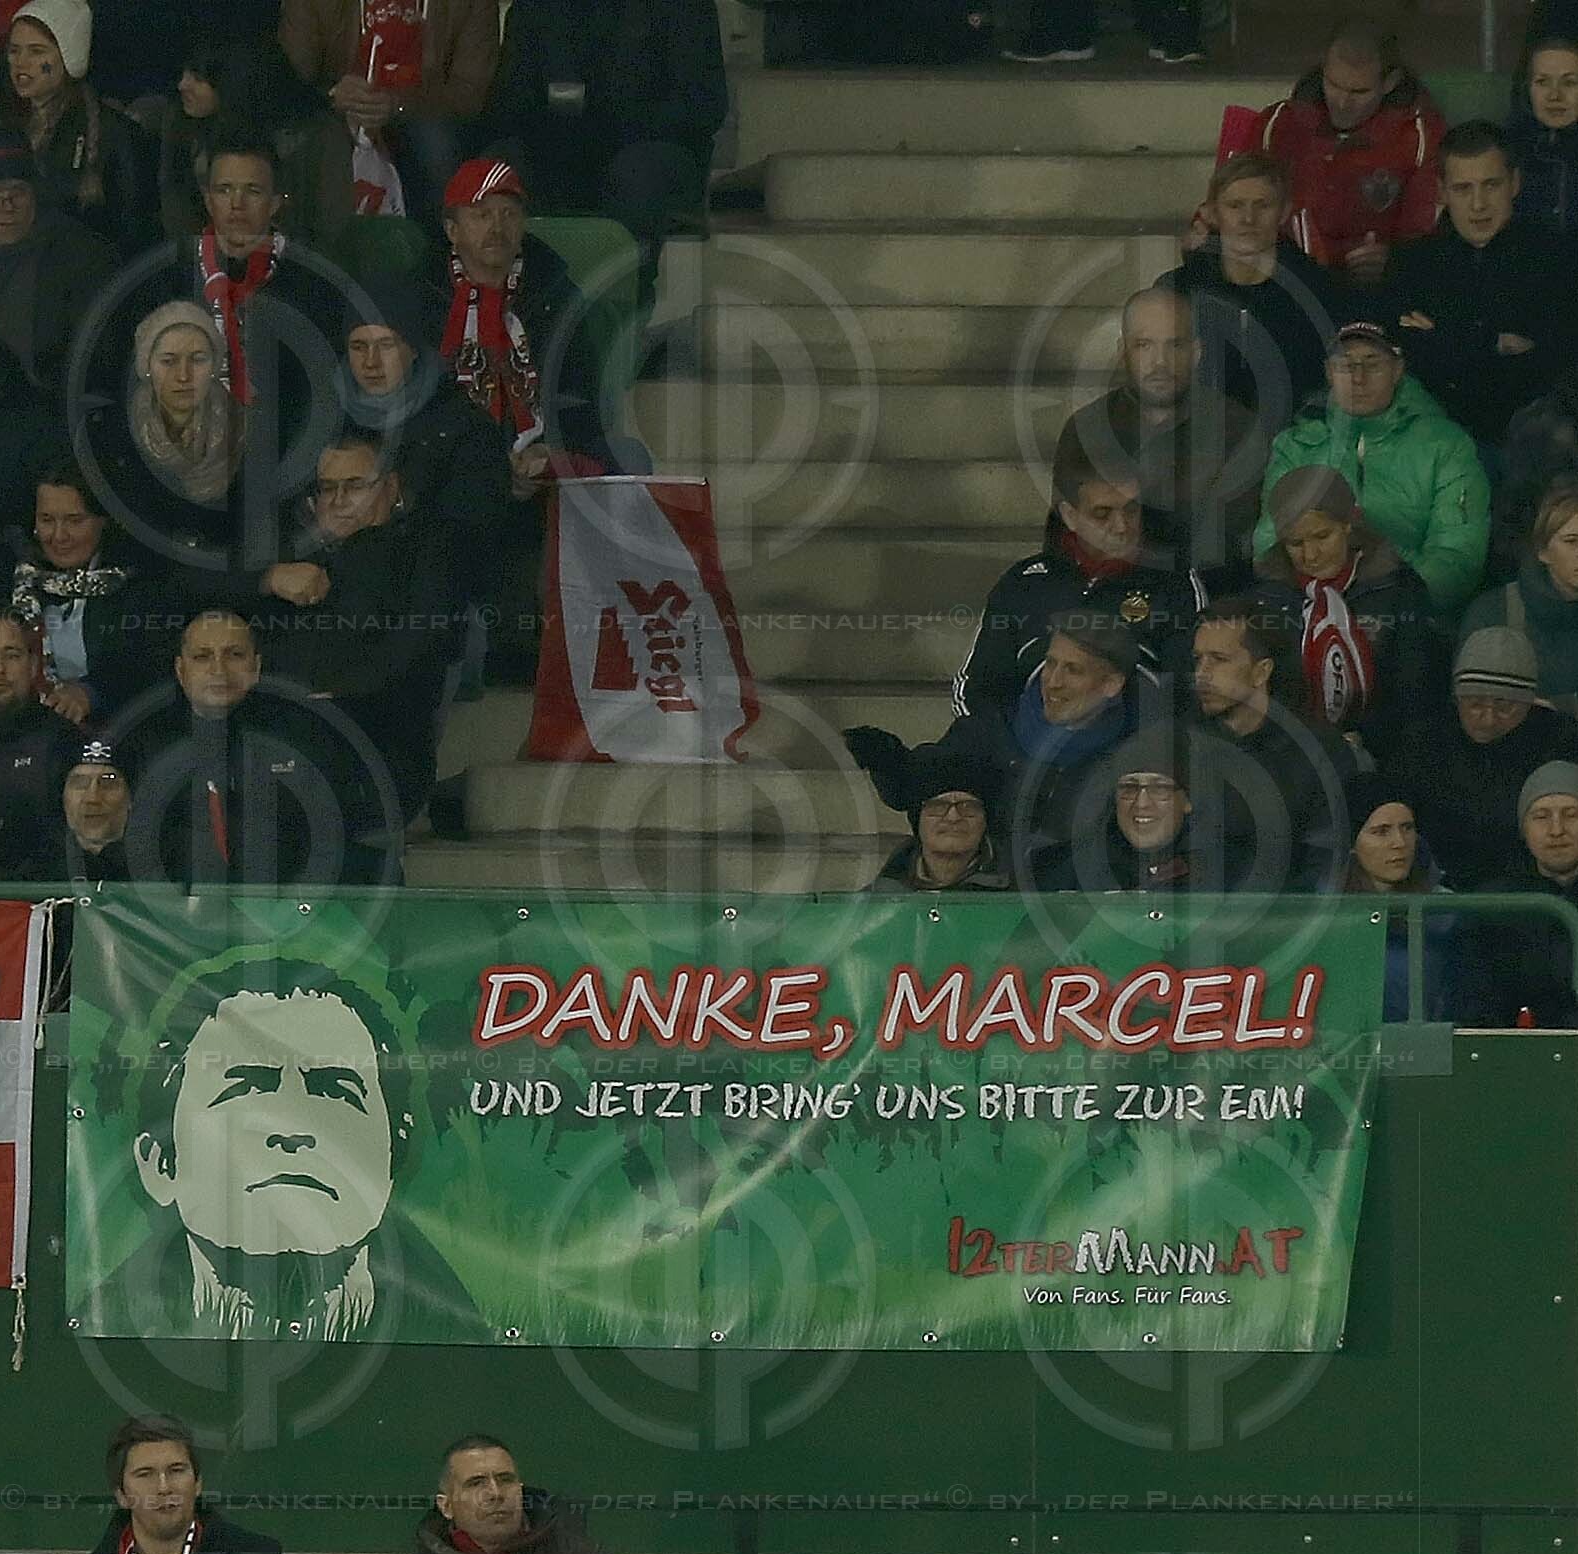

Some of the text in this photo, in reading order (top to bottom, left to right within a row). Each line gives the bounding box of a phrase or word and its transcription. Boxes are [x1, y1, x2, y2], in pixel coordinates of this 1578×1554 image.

[616, 579, 699, 713] Stiegl
[477, 967, 1319, 1055] DANKE, MARCEL!
[470, 1080, 562, 1117] UND
[575, 1081, 713, 1119] JETZT
[875, 1084, 967, 1120] UNS
[979, 1082, 1101, 1121] BITTE
[1113, 1084, 1206, 1121] ZUR
[1220, 1084, 1304, 1121] EM!
[1023, 1286, 1232, 1304] Von Fans. Für Fans.
